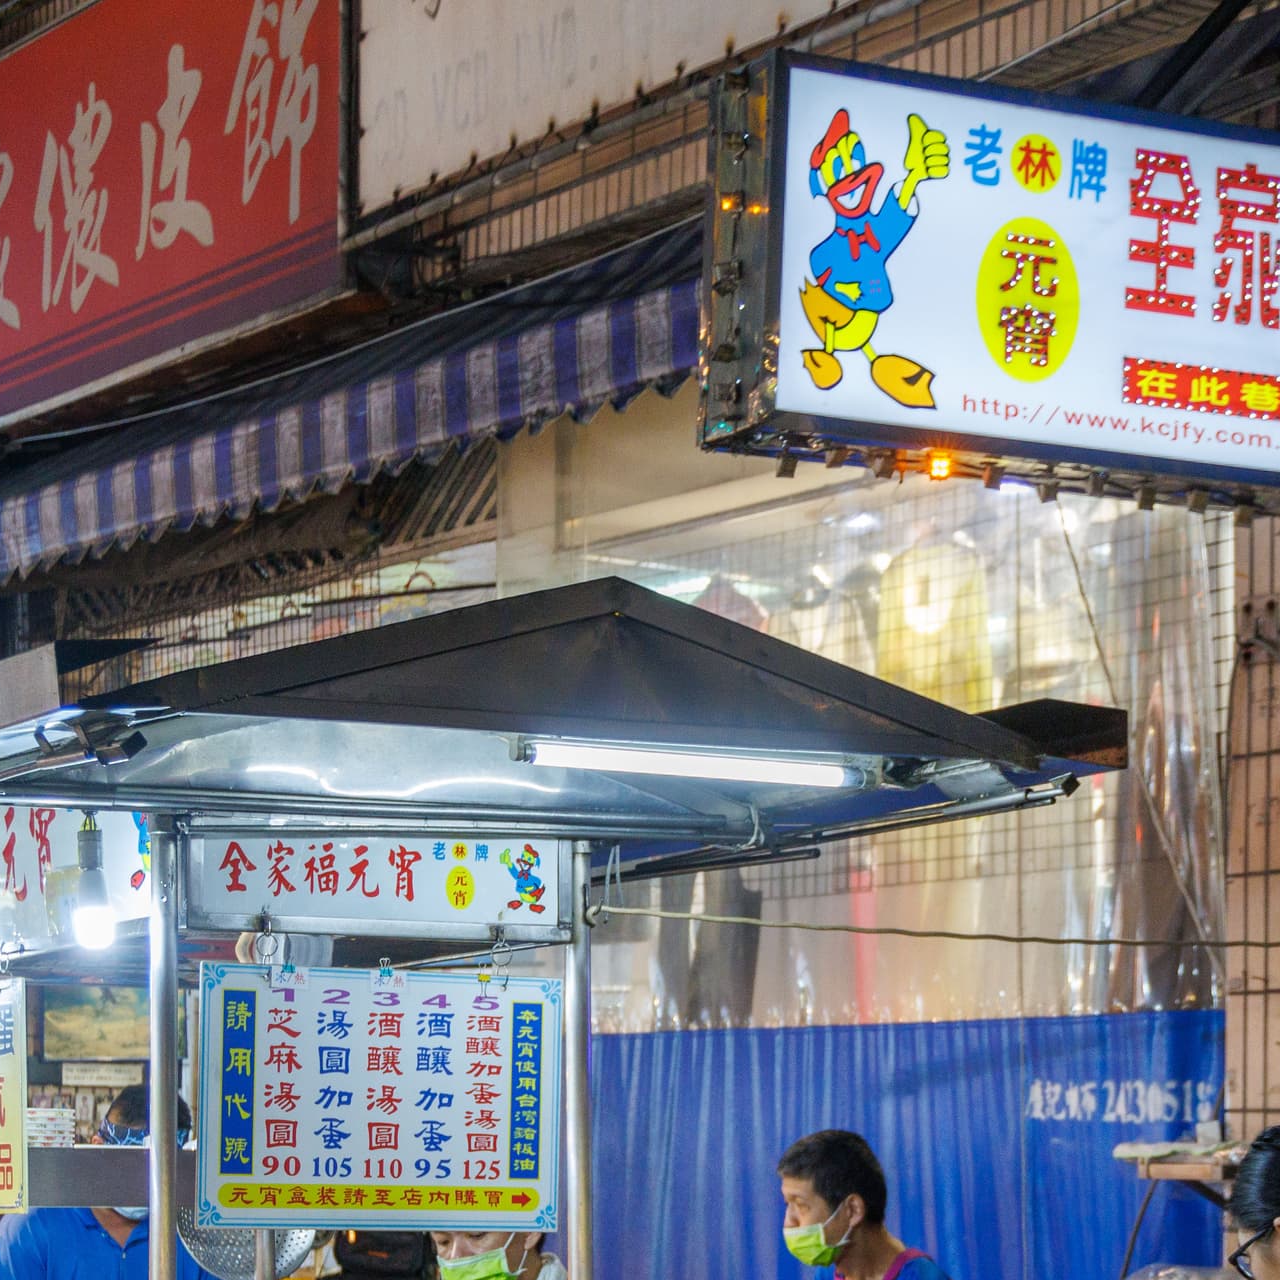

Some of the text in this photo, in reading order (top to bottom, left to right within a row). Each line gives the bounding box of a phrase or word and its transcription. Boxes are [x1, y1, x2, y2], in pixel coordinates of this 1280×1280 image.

[963, 122, 1108, 203] 老林牌
[999, 231, 1060, 368] 元宵
[432, 841, 489, 861] 老林牌
[219, 840, 423, 902] 全家福元宵
[453, 870, 468, 906] 元宵
[272, 988, 295, 1002] 1
[322, 989, 351, 1005] 2
[373, 992, 401, 1006] 3
[422, 994, 452, 1009] 4
[472, 996, 501, 1012] 5
[223, 1000, 253, 1164] 請用代號
[264, 1008, 303, 1148] 芝麻湯圓
[314, 1010, 354, 1150] 湯圓加蛋
[366, 1012, 405, 1151] 酒釀湯圓
[414, 1012, 455, 1152] 酒釀加蛋
[465, 1015, 504, 1153] 酒釀加蛋湯圓
[262, 1155, 302, 1176] 90
[312, 1156, 352, 1179] 105
[363, 1158, 403, 1180] 110
[414, 1159, 452, 1179] 95
[463, 1160, 502, 1181] 125
